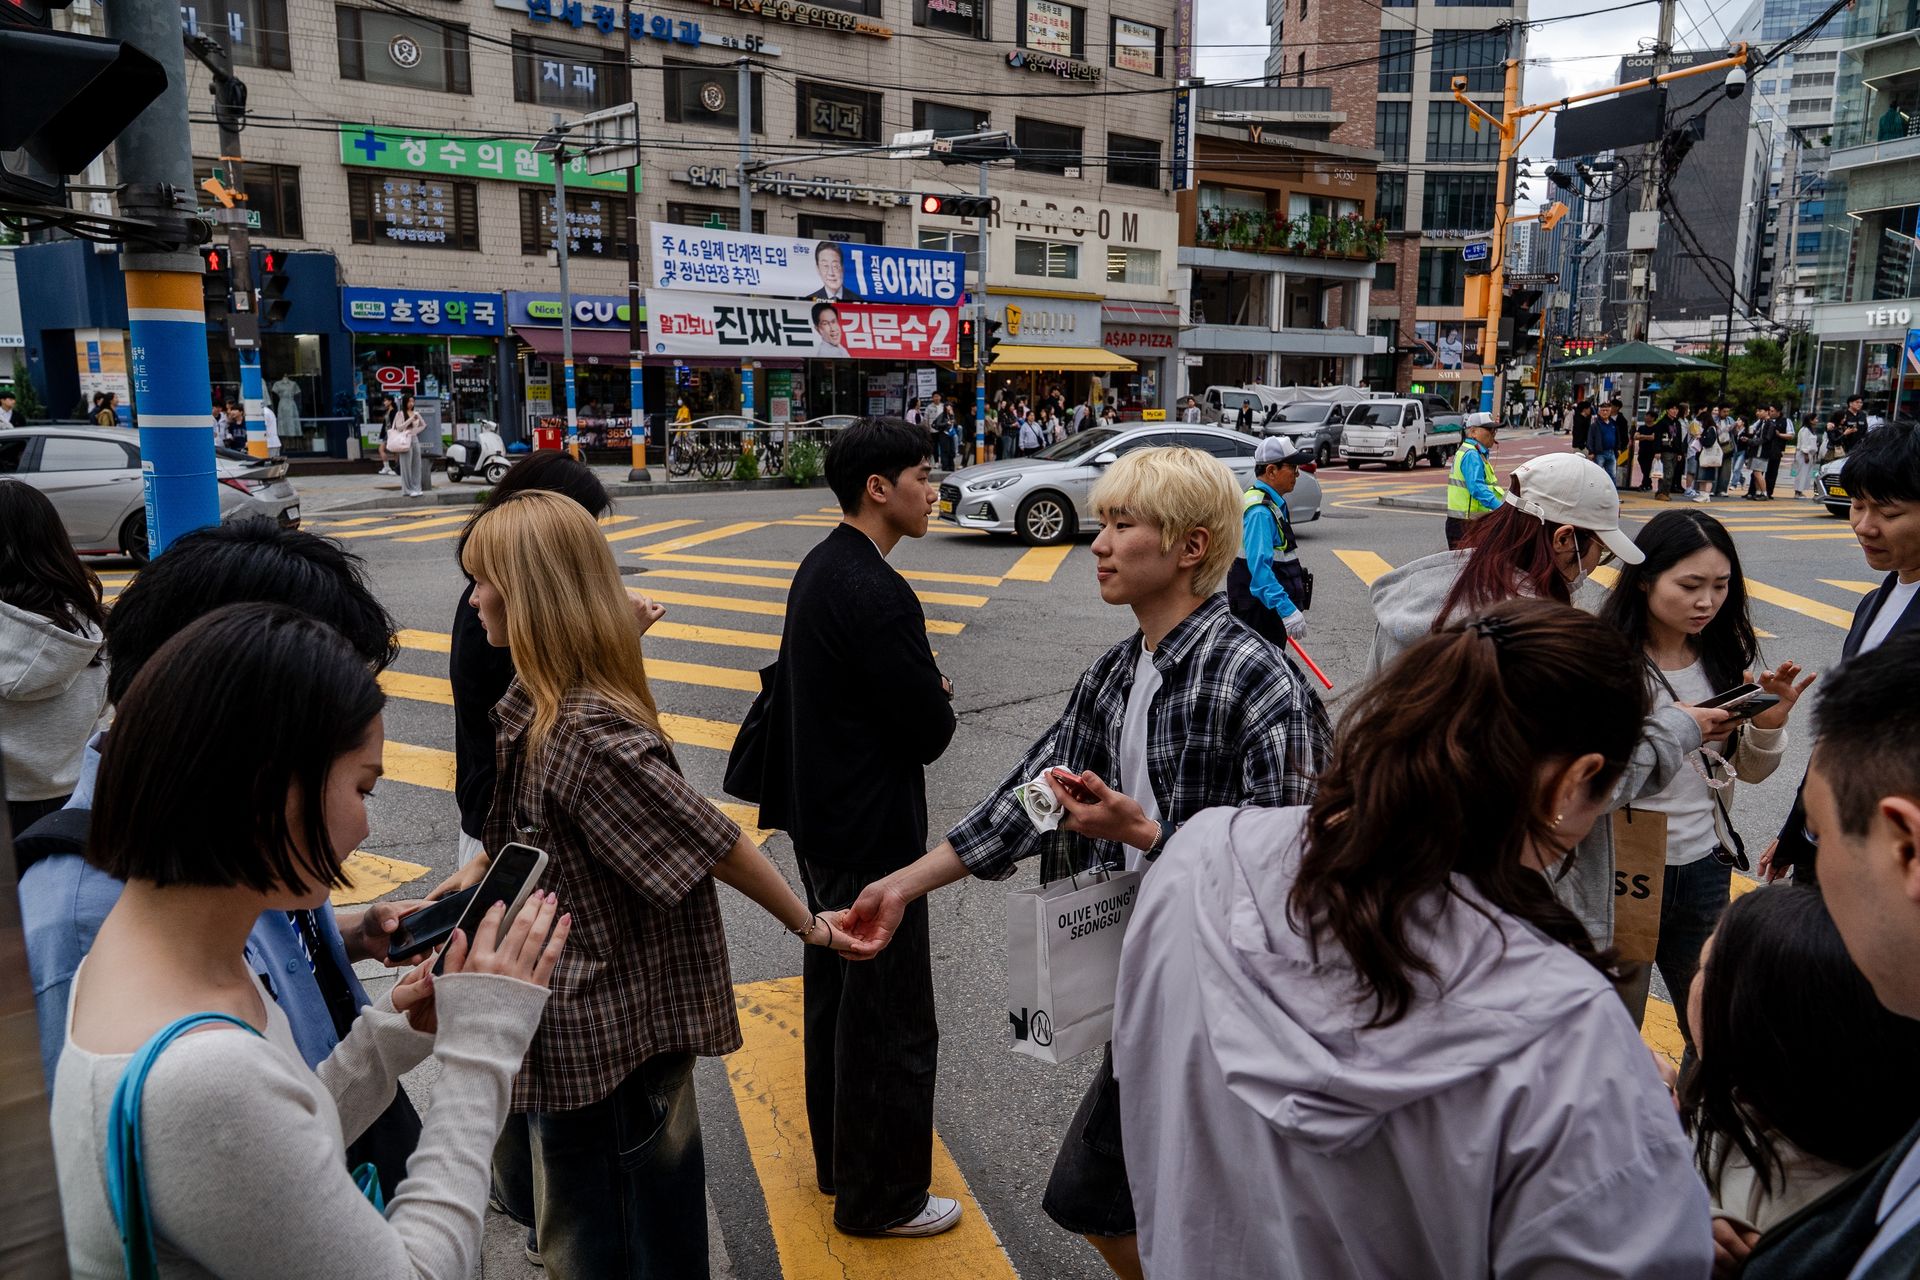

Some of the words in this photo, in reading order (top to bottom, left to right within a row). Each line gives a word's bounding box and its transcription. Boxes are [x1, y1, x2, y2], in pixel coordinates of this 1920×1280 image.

[543, 61, 597, 93] 치과
[816, 103, 861, 133] 치과
[400, 136, 540, 178] 성수의원
[689, 164, 728, 189] 연세
[662, 235, 675, 256] 주
[727, 243, 762, 265] 단계적
[765, 247, 787, 267] 도입
[664, 260, 677, 281] 및
[680, 262, 730, 284] 정년연장
[733, 266, 761, 286] 추진!
[851, 250, 868, 295] 1
[871, 255, 884, 295] 지금은
[881, 256, 955, 299] 이재명
[391, 298, 496, 326] 호정약국
[535, 305, 555, 315] Nice
[575, 301, 613, 323] CU
[1865, 306, 1912, 326] TÉTO
[660, 313, 714, 336] 알고보니
[713, 306, 814, 347] 진짜는
[840, 311, 927, 351] 김문수
[928, 308, 951, 348] 2
[1105, 332, 1136, 348] A$AP
[1139, 333, 1173, 348] PIZZA
[376, 365, 420, 394] 약
[1058, 905, 1091, 929] OLIVE
[1070, 910, 1122, 940] SEONGSU
